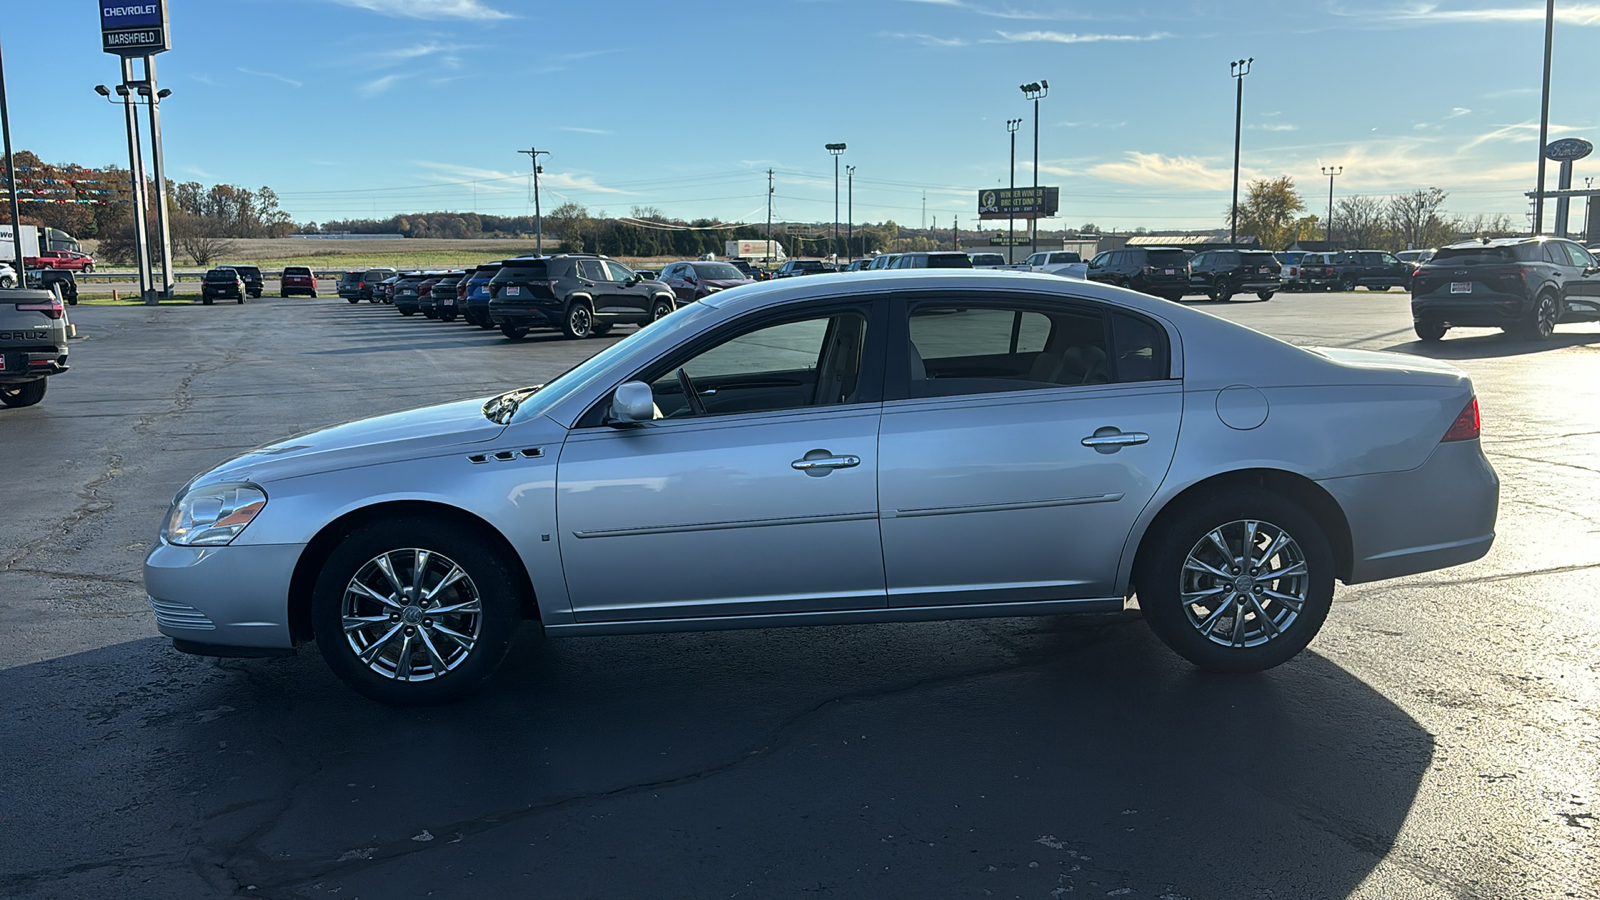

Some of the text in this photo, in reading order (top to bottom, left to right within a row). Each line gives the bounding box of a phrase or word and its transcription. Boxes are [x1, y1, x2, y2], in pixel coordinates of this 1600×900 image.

[103, 4, 157, 17] CHEVROLET
[108, 31, 155, 45] MARSHFIELD
[1551, 143, 1578, 157] Ford
[0, 331, 48, 341] CRUZ
